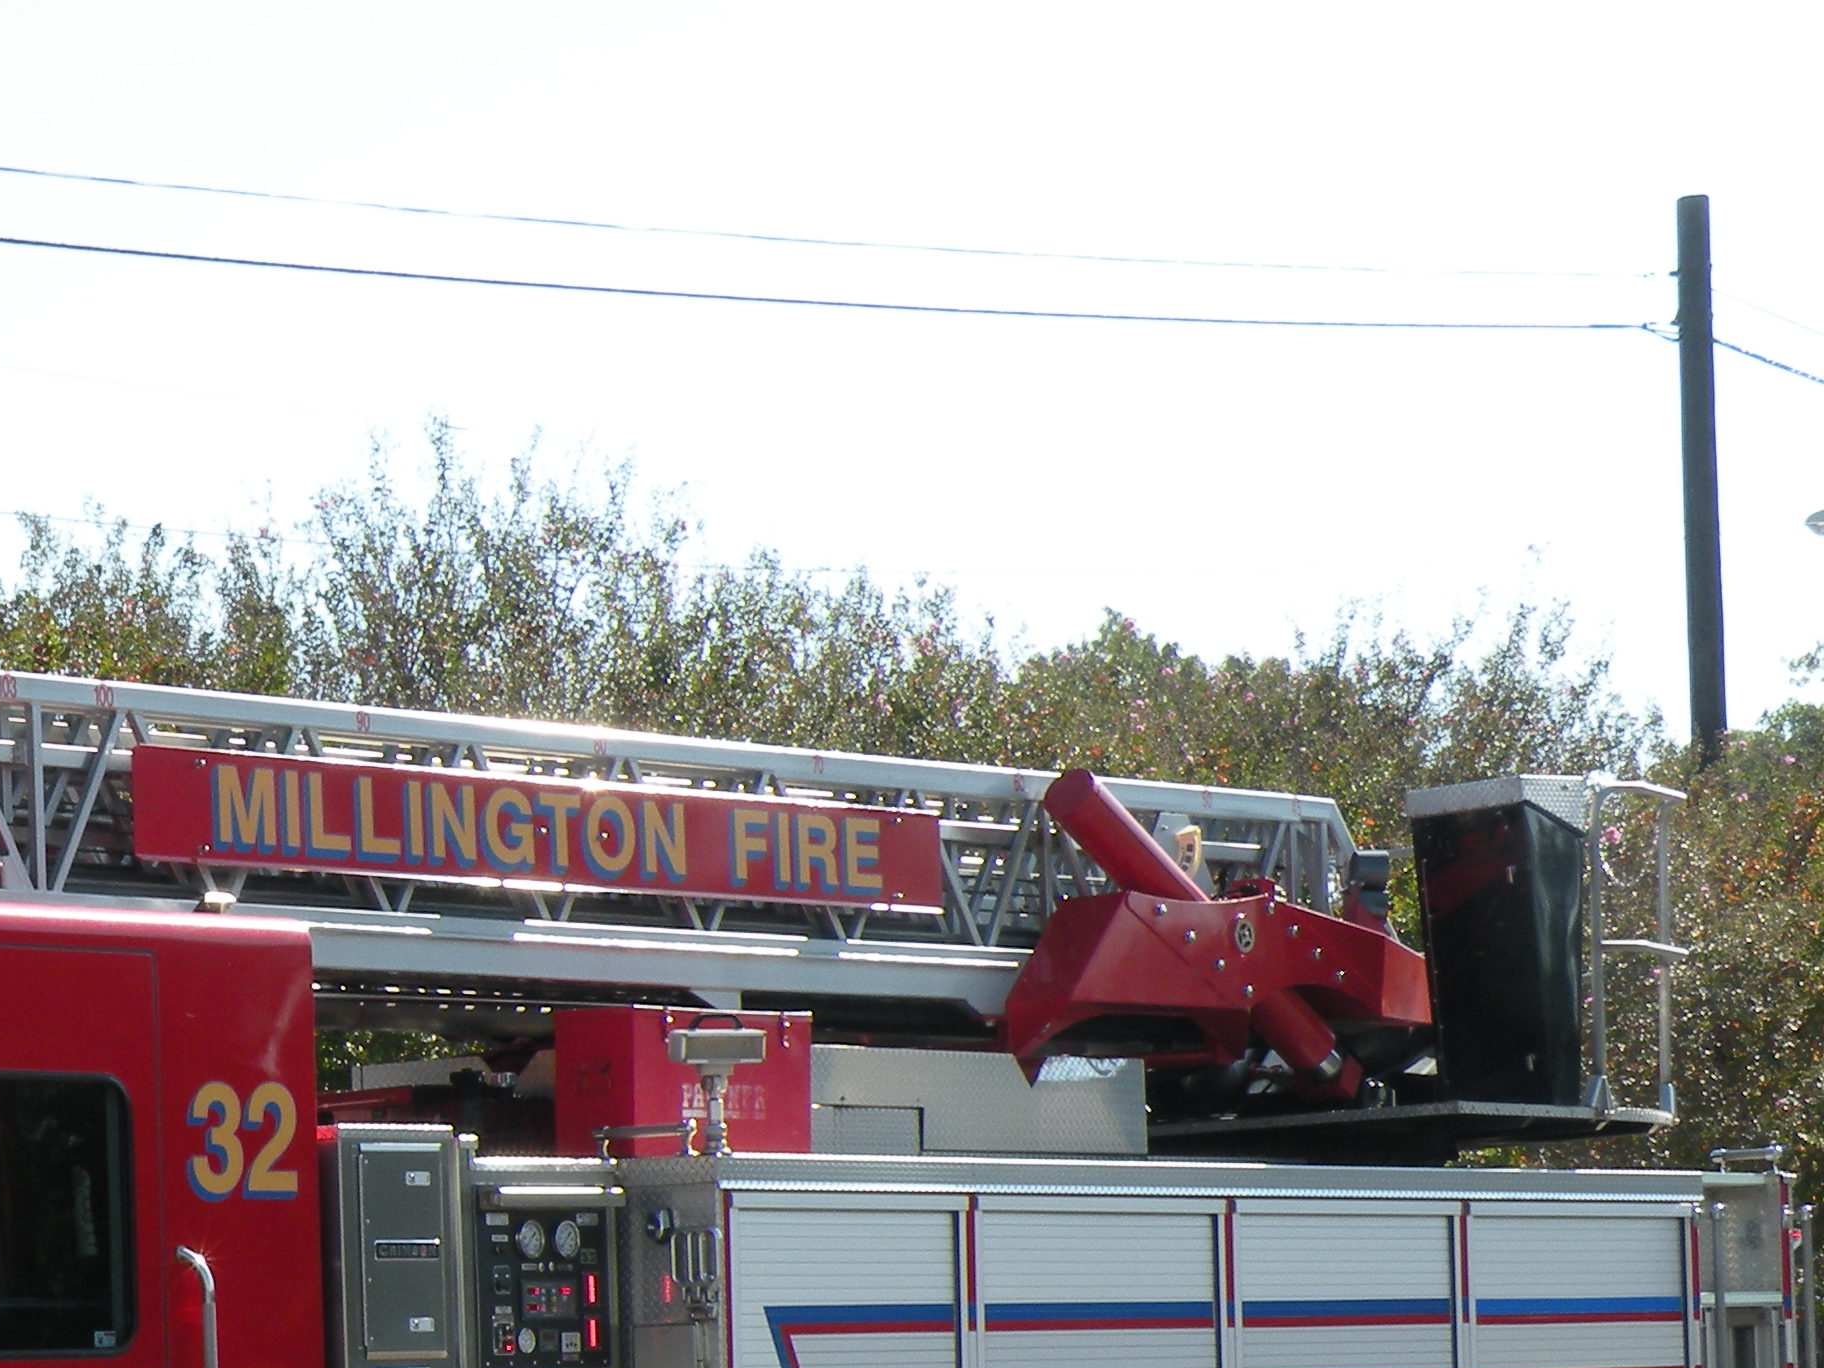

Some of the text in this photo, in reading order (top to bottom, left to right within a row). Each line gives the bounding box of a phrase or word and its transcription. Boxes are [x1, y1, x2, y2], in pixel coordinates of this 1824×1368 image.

[94, 683, 114, 707] 100
[356, 711, 370, 731] 90
[593, 738, 607, 756] 80
[812, 755, 824, 774] 70
[212, 765, 884, 897] MILLINGTON FIRE
[681, 1083, 766, 1109] PANER
[187, 1081, 298, 1202] 32
